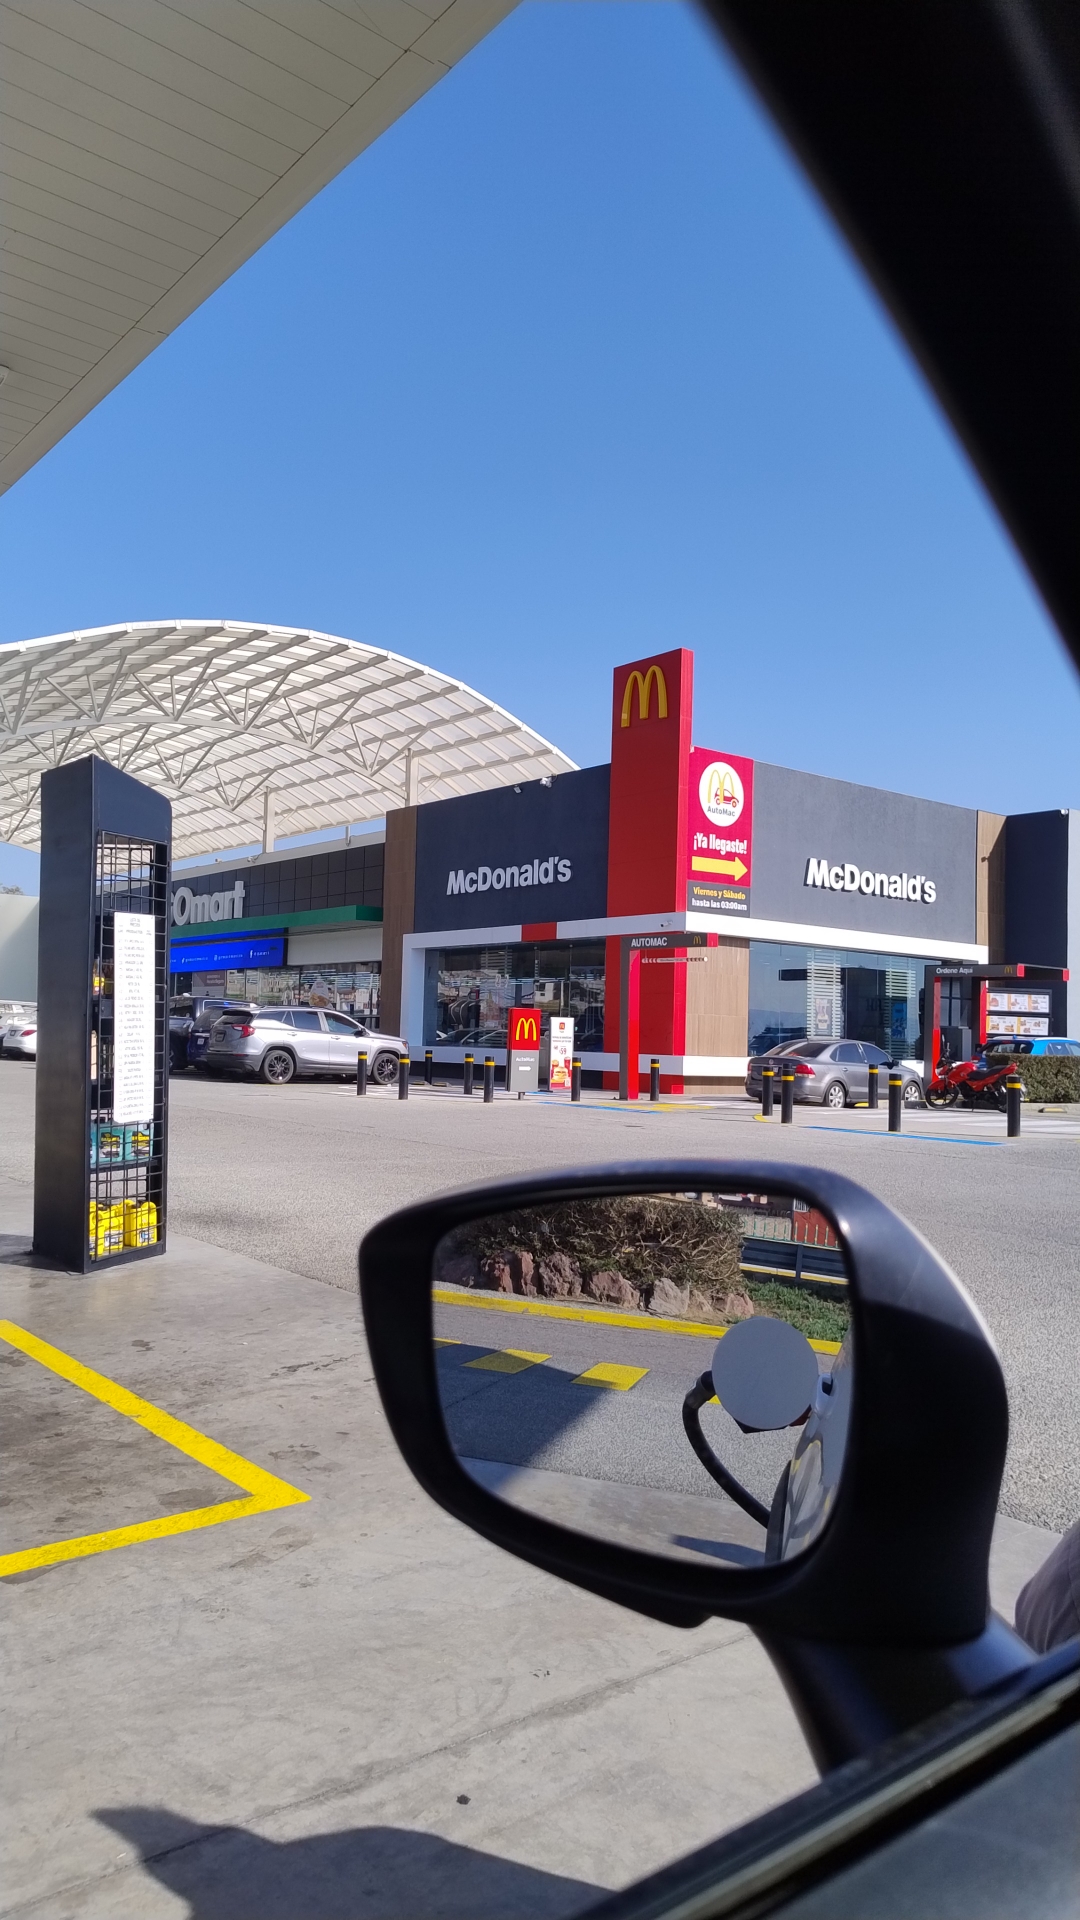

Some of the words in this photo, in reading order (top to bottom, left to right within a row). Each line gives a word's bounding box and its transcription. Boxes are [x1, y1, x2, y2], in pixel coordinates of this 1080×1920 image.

[707, 805, 736, 817] AutoMac
[693, 832, 708, 850] ¡Ya
[709, 834, 748, 855] llegaste!
[446, 856, 572, 895] McDonald's
[804, 857, 937, 904] McDonald's
[693, 886, 718, 897] Viernes
[717, 890, 723, 899] y
[723, 889, 746, 900] Sábado
[171, 880, 246, 926] Omart
[691, 898, 710, 908] hasta
[710, 899, 721, 909] las
[721, 900, 747, 911] 03:00am
[631, 937, 668, 947] AUTOMAC
